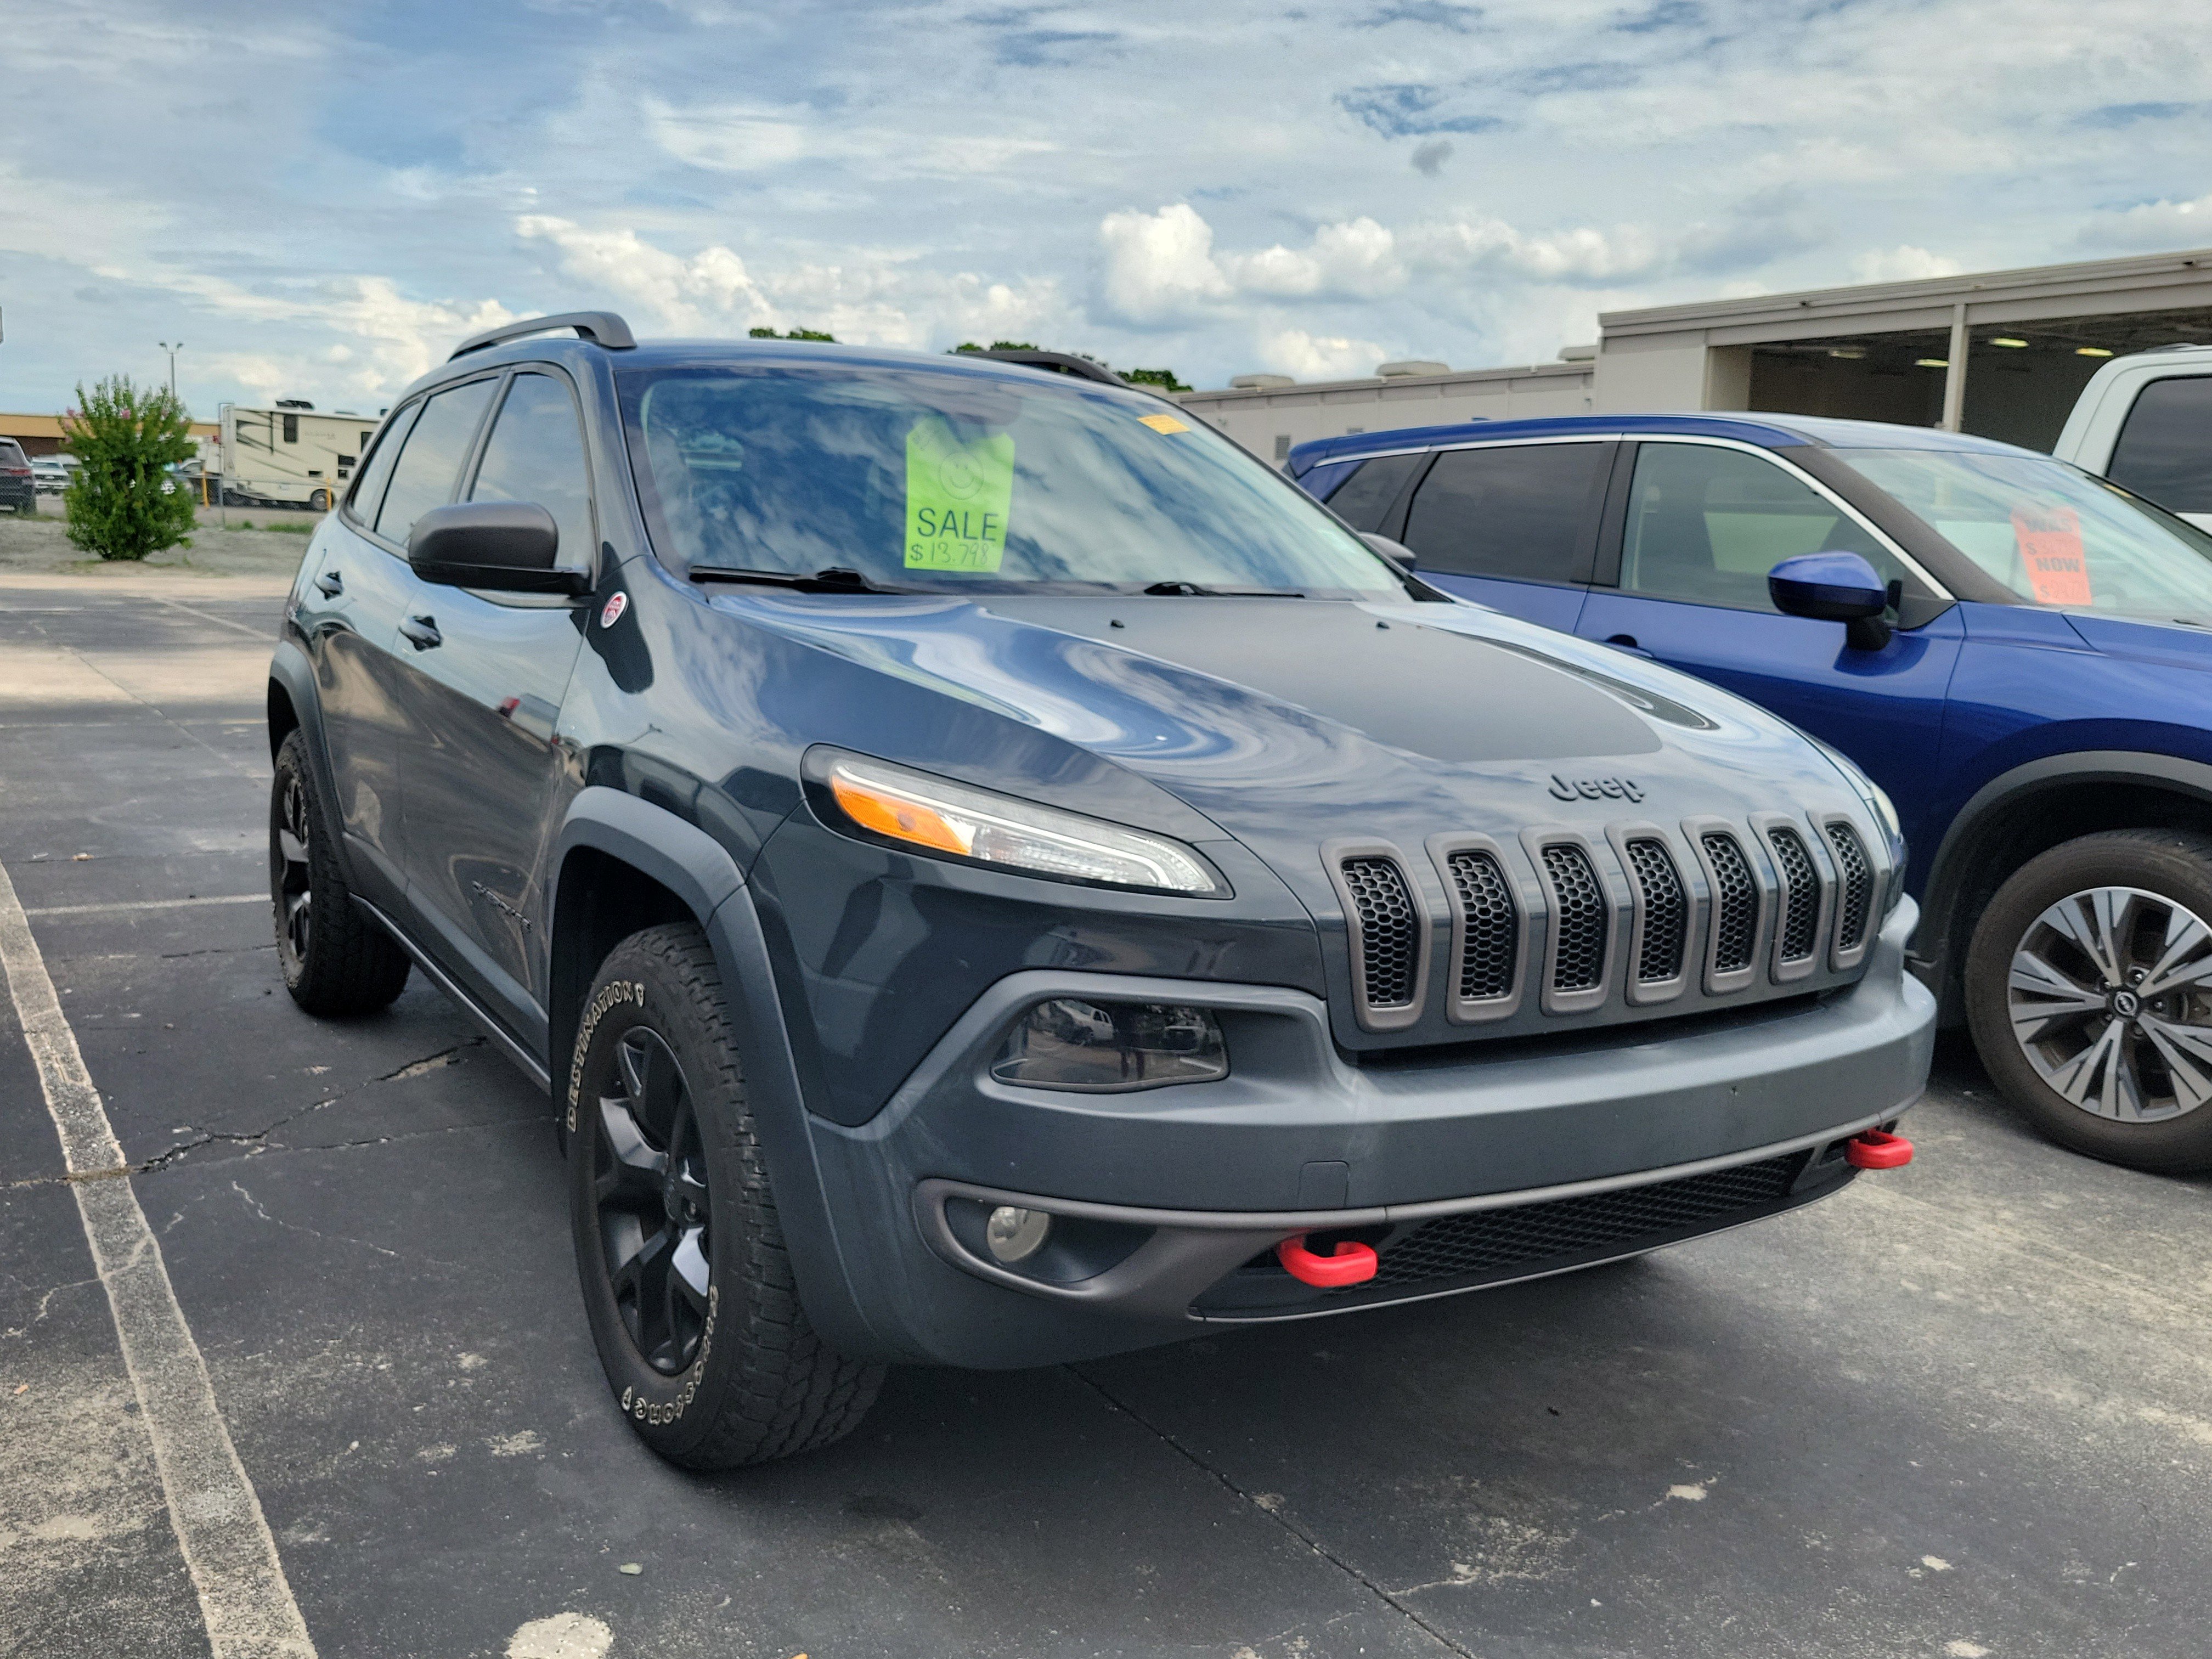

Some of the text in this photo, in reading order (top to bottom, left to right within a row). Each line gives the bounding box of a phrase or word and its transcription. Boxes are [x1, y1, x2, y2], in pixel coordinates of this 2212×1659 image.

[917, 507, 998, 541] SALE
[2036, 558, 2079, 572] NOW
[1547, 774, 1646, 803] Jeep
[567, 980, 634, 1133] DESTINATION
